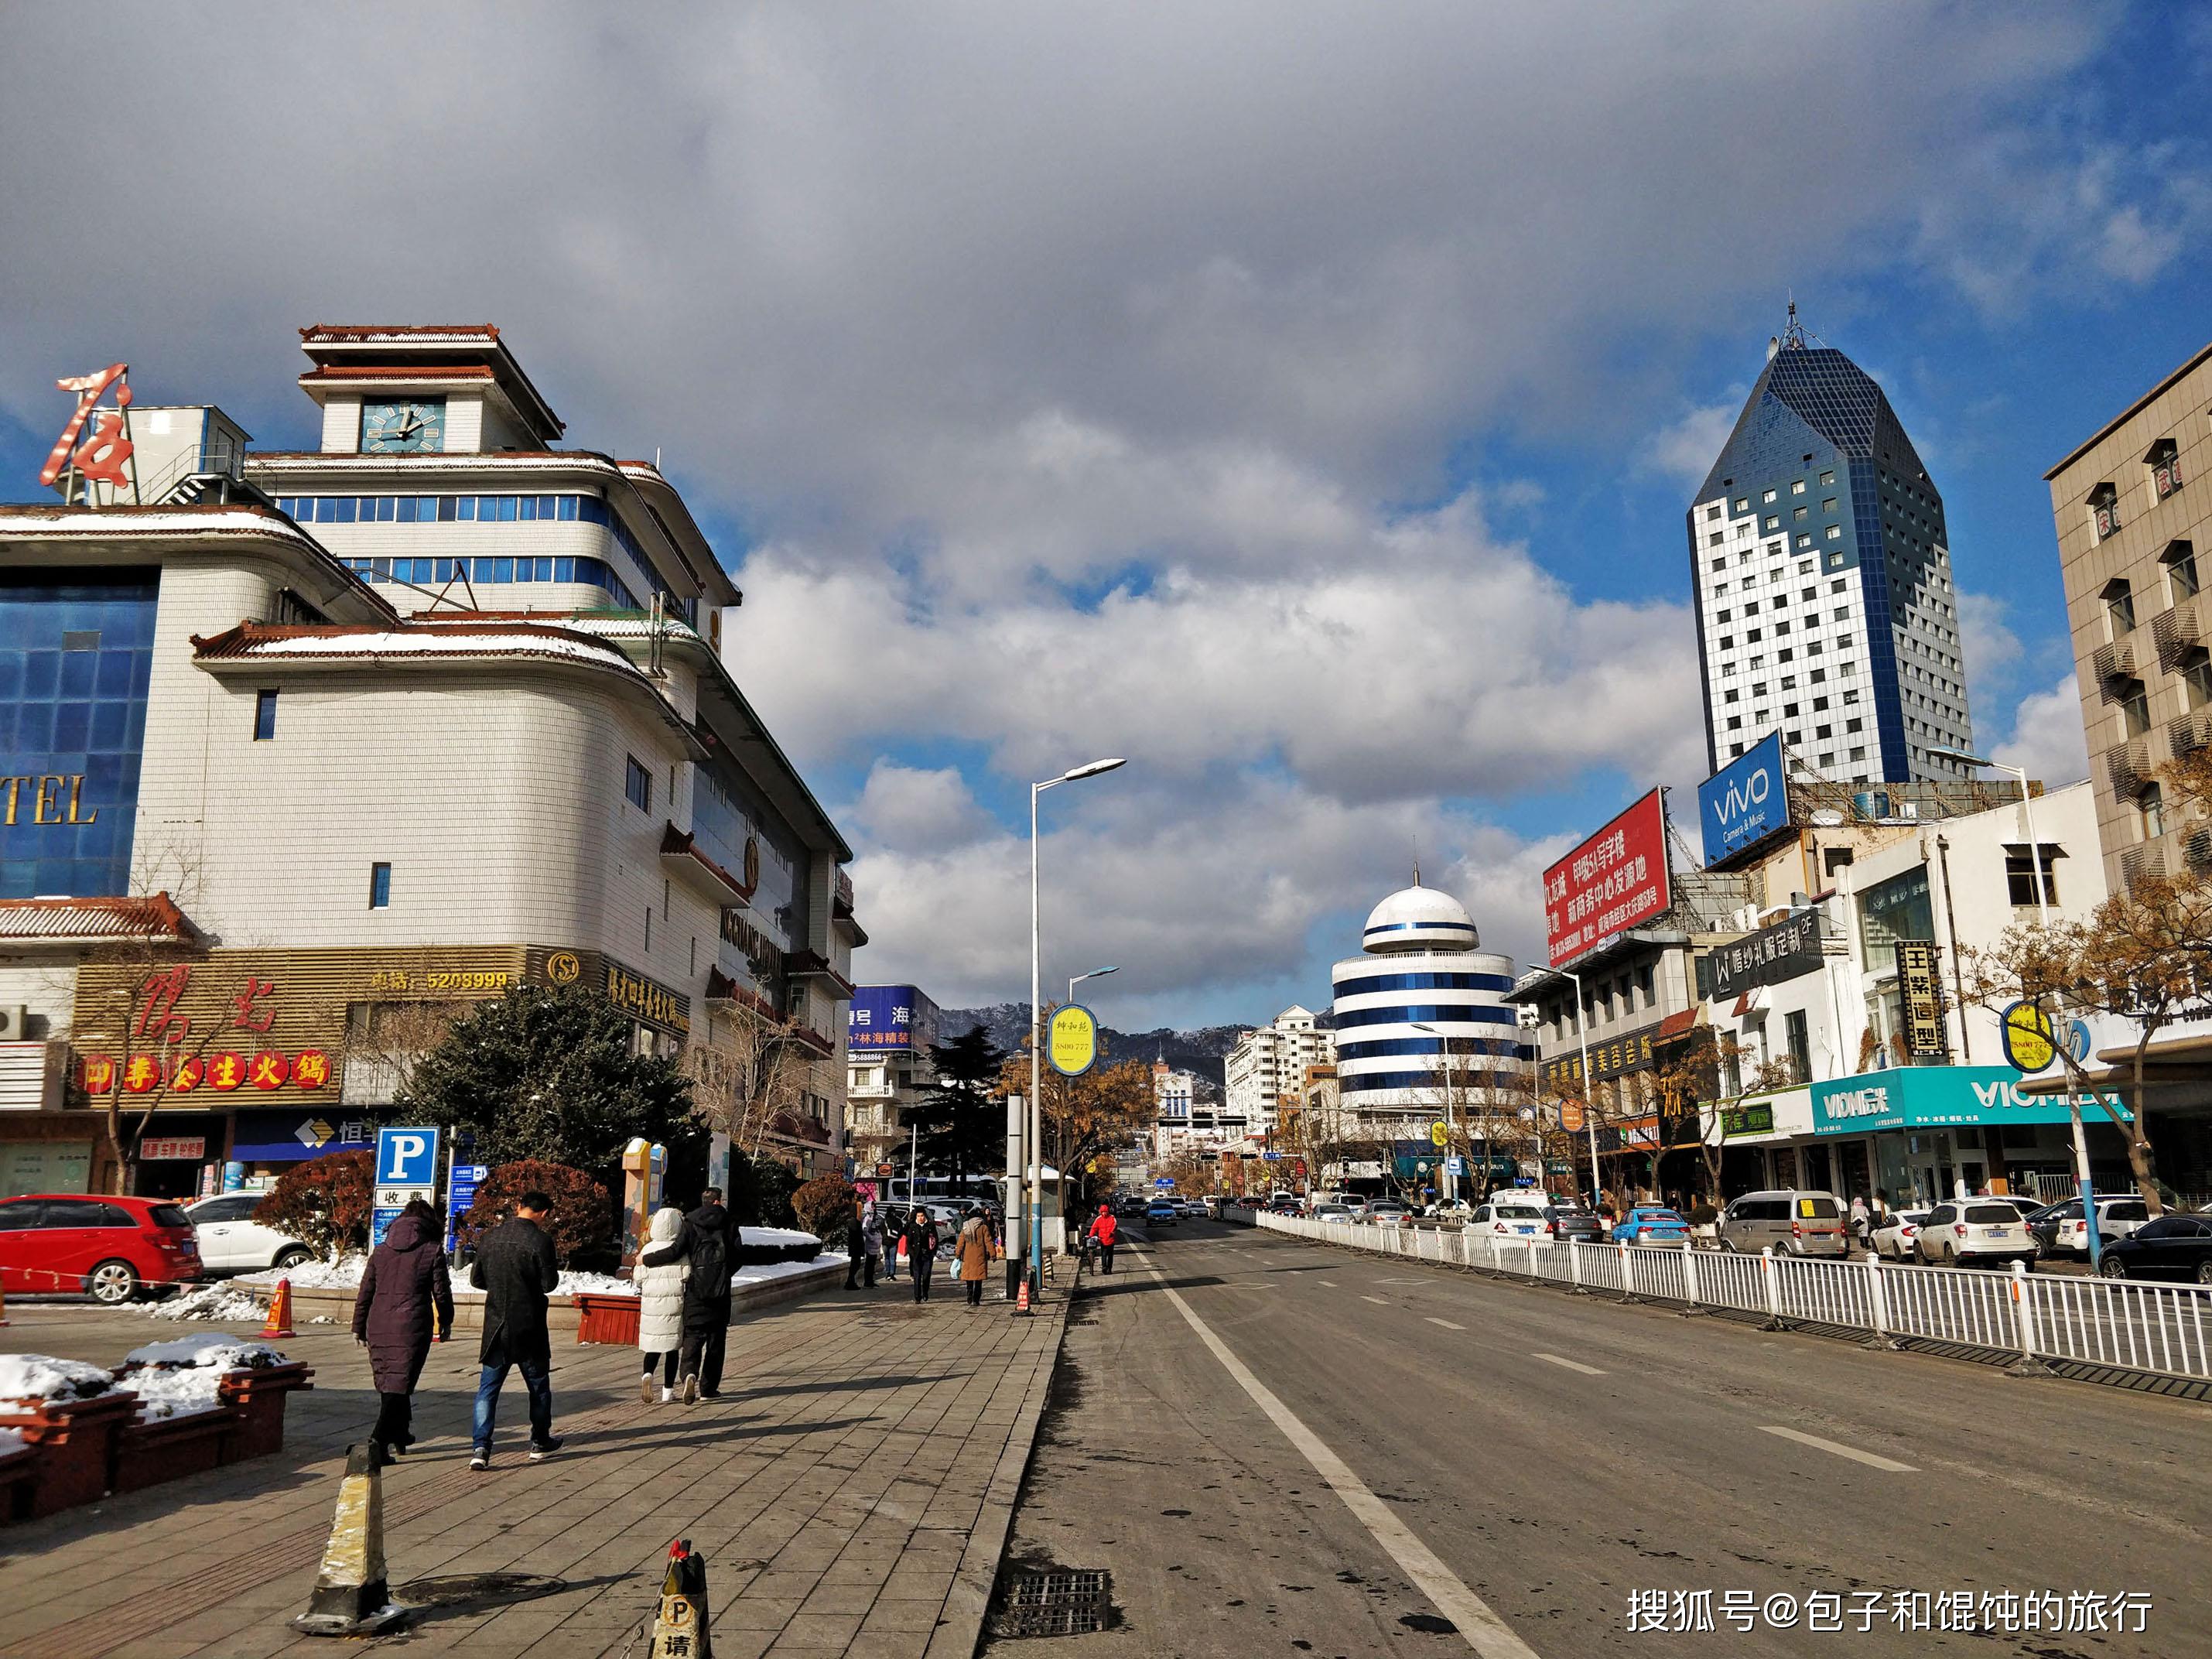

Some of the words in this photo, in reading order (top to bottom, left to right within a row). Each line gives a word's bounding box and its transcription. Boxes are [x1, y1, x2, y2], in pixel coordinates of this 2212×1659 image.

[1714, 768, 1769, 826] vivo
[1723, 825, 1744, 843] Camera
[1744, 819, 1749, 831] &
[1749, 809, 1766, 828] Music
[1567, 853, 1647, 925] 新商务中心发源地
[1732, 925, 1802, 974] 婚纱礼服定制
[1801, 915, 1813, 935] 2F
[1907, 950, 1937, 1046] 王紫造型
[388, 1136, 425, 1178] P
[674, 1602, 688, 1623] P
[665, 1635, 691, 1657] 请
